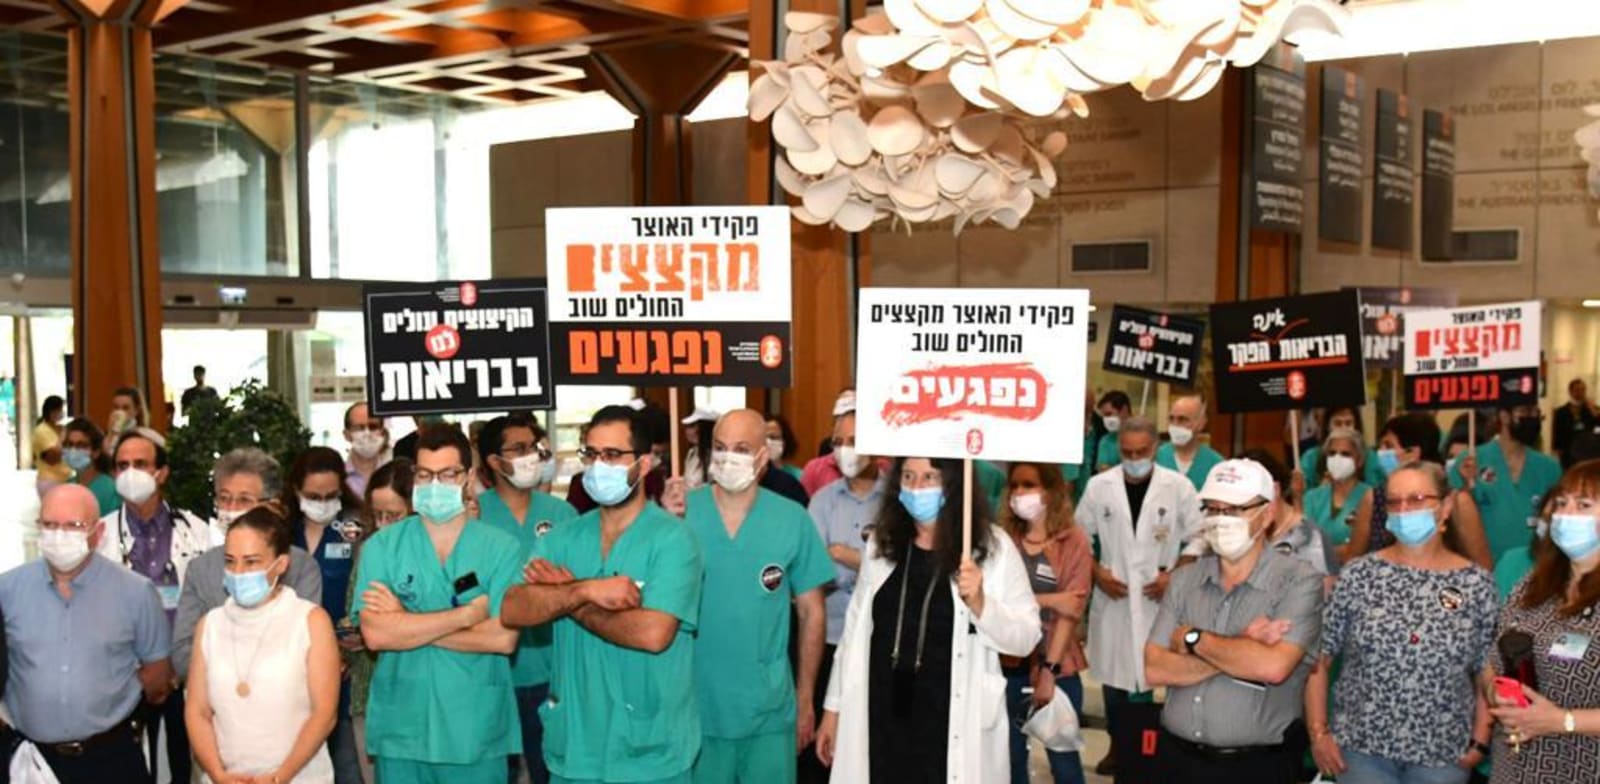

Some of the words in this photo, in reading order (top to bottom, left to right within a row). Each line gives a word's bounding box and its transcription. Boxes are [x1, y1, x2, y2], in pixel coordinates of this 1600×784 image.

[631, 216, 694, 237] האוצר
[702, 215, 759, 240] פקידי
[566, 242, 760, 302] מקצצים
[568, 297, 607, 318] שוב
[615, 293, 684, 318] החולים
[871, 304, 944, 327] מקצצים
[952, 304, 1011, 325] האוצר
[1019, 305, 1074, 329] פקידי
[383, 308, 439, 333] עולים
[443, 307, 534, 333] הקיצוצים
[1252, 307, 1287, 332] אינה
[568, 330, 724, 375] נפגעים
[911, 332, 949, 352] שוב
[956, 331, 1023, 354] החולים
[1279, 334, 1348, 361] הבריאות
[1416, 323, 1521, 357] מקצצים
[1110, 344, 1190, 379] בבריאות
[1227, 341, 1271, 368] הפקר
[379, 357, 543, 401] בבריאות
[1414, 374, 1499, 404] נפגעים
[892, 376, 1037, 408] נפגעים
